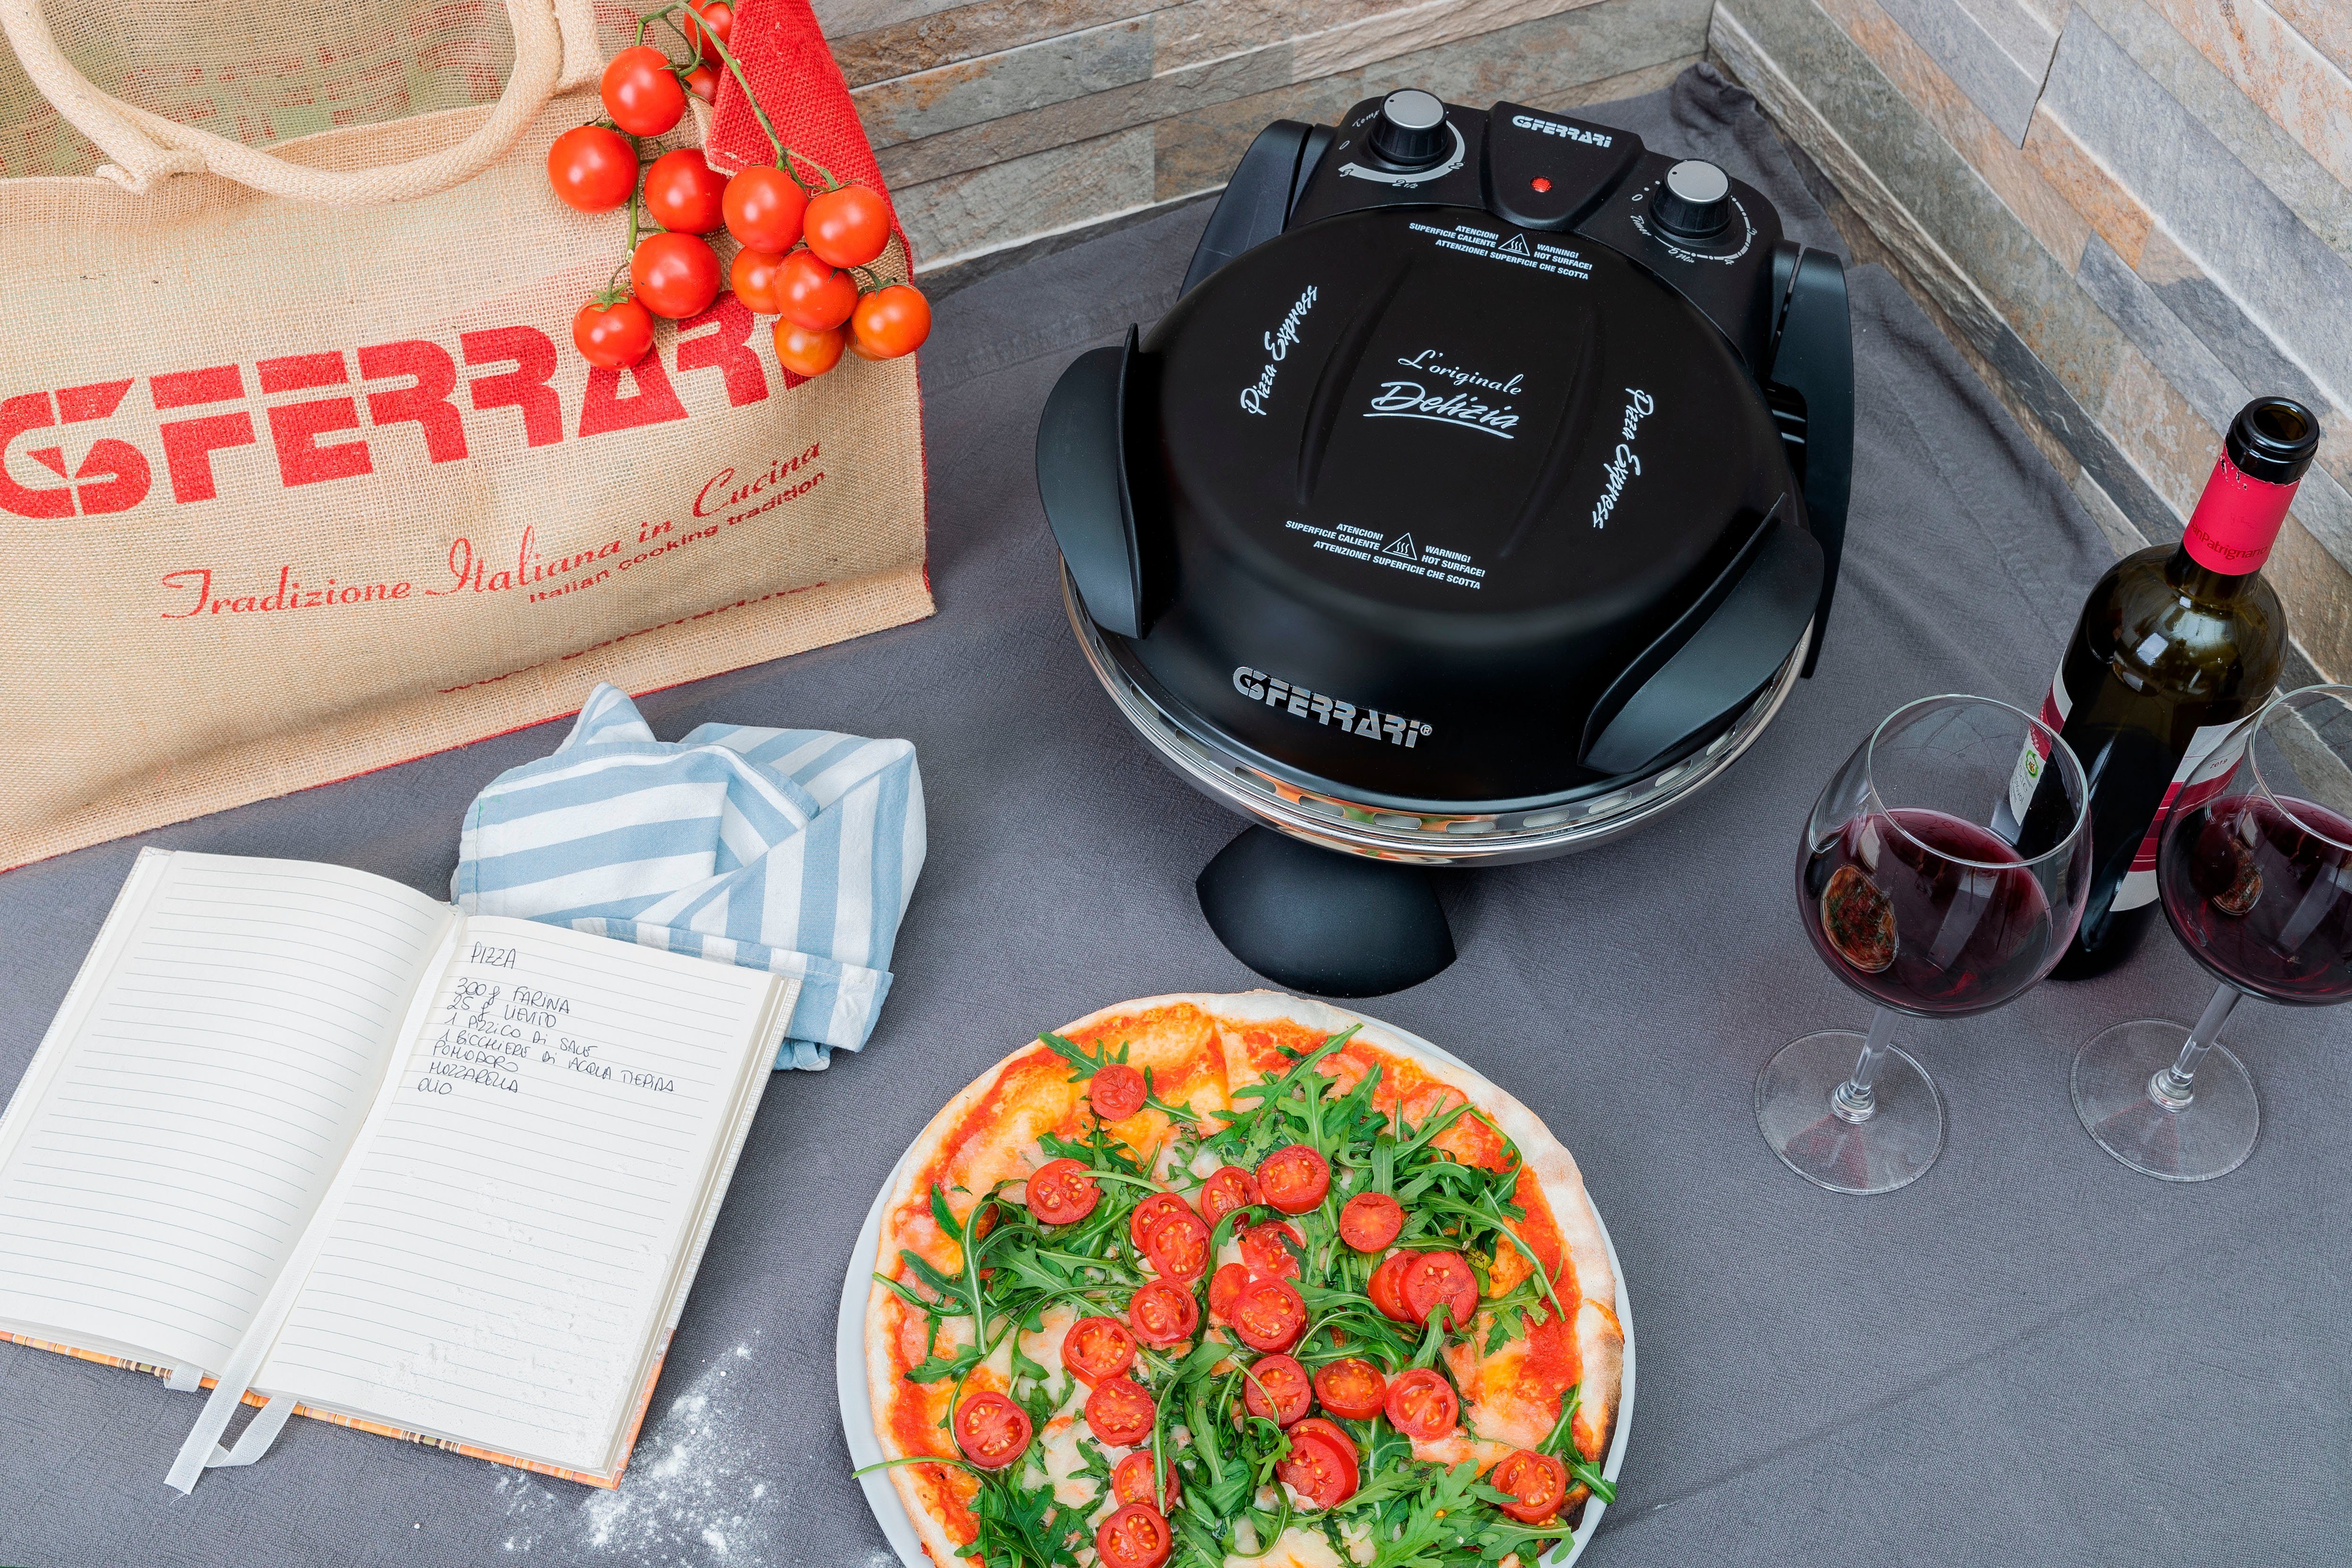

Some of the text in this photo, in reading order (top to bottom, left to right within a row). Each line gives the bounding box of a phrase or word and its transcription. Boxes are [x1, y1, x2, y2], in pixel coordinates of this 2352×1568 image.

[1409, 222, 1497, 248] SUPERFICIE CALIENTE
[1455, 225, 1498, 240] ATENCION!
[1630, 215, 1651, 236] Timer
[1435, 239, 1588, 280] ATTENZIONE! SUPERFICIE CHE SCOTTA
[1533, 251, 1592, 270] HOT SURFACE!
[1536, 244, 1579, 259] WARNING!
[1240, 285, 1317, 415] Pizza Express
[1397, 349, 1524, 395] L'originale
[1371, 381, 1519, 429] Delizia
[1592, 388, 1654, 529] Pizza Express
[161, 441, 820, 619] Tradizione Italiana in Cucina
[529, 472, 826, 603] Italian cooking tradition
[1285, 520, 1380, 550] SUPERFICIE CALIENTE
[1336, 523, 1383, 540] ATENCION!
[1313, 540, 1481, 590] ATTENZIONE! SUPERFICIE CHE SCOTTA
[1421, 555, 1486, 577] HOT SURFACE!
[1425, 545, 1471, 563] WARNING!
[471, 941, 516, 969] PIZZA
[447, 994, 474, 1010] 25
[455, 978, 487, 996] 300
[444, 1012, 457, 1025] 1
[560, 1037, 598, 1057] SALE
[433, 1040, 518, 1072] POMODORO
[440, 1029, 450, 1041] 1
[568, 1057, 611, 1080] ACQUA
[429, 1061, 518, 1093] MOZZARELLA
